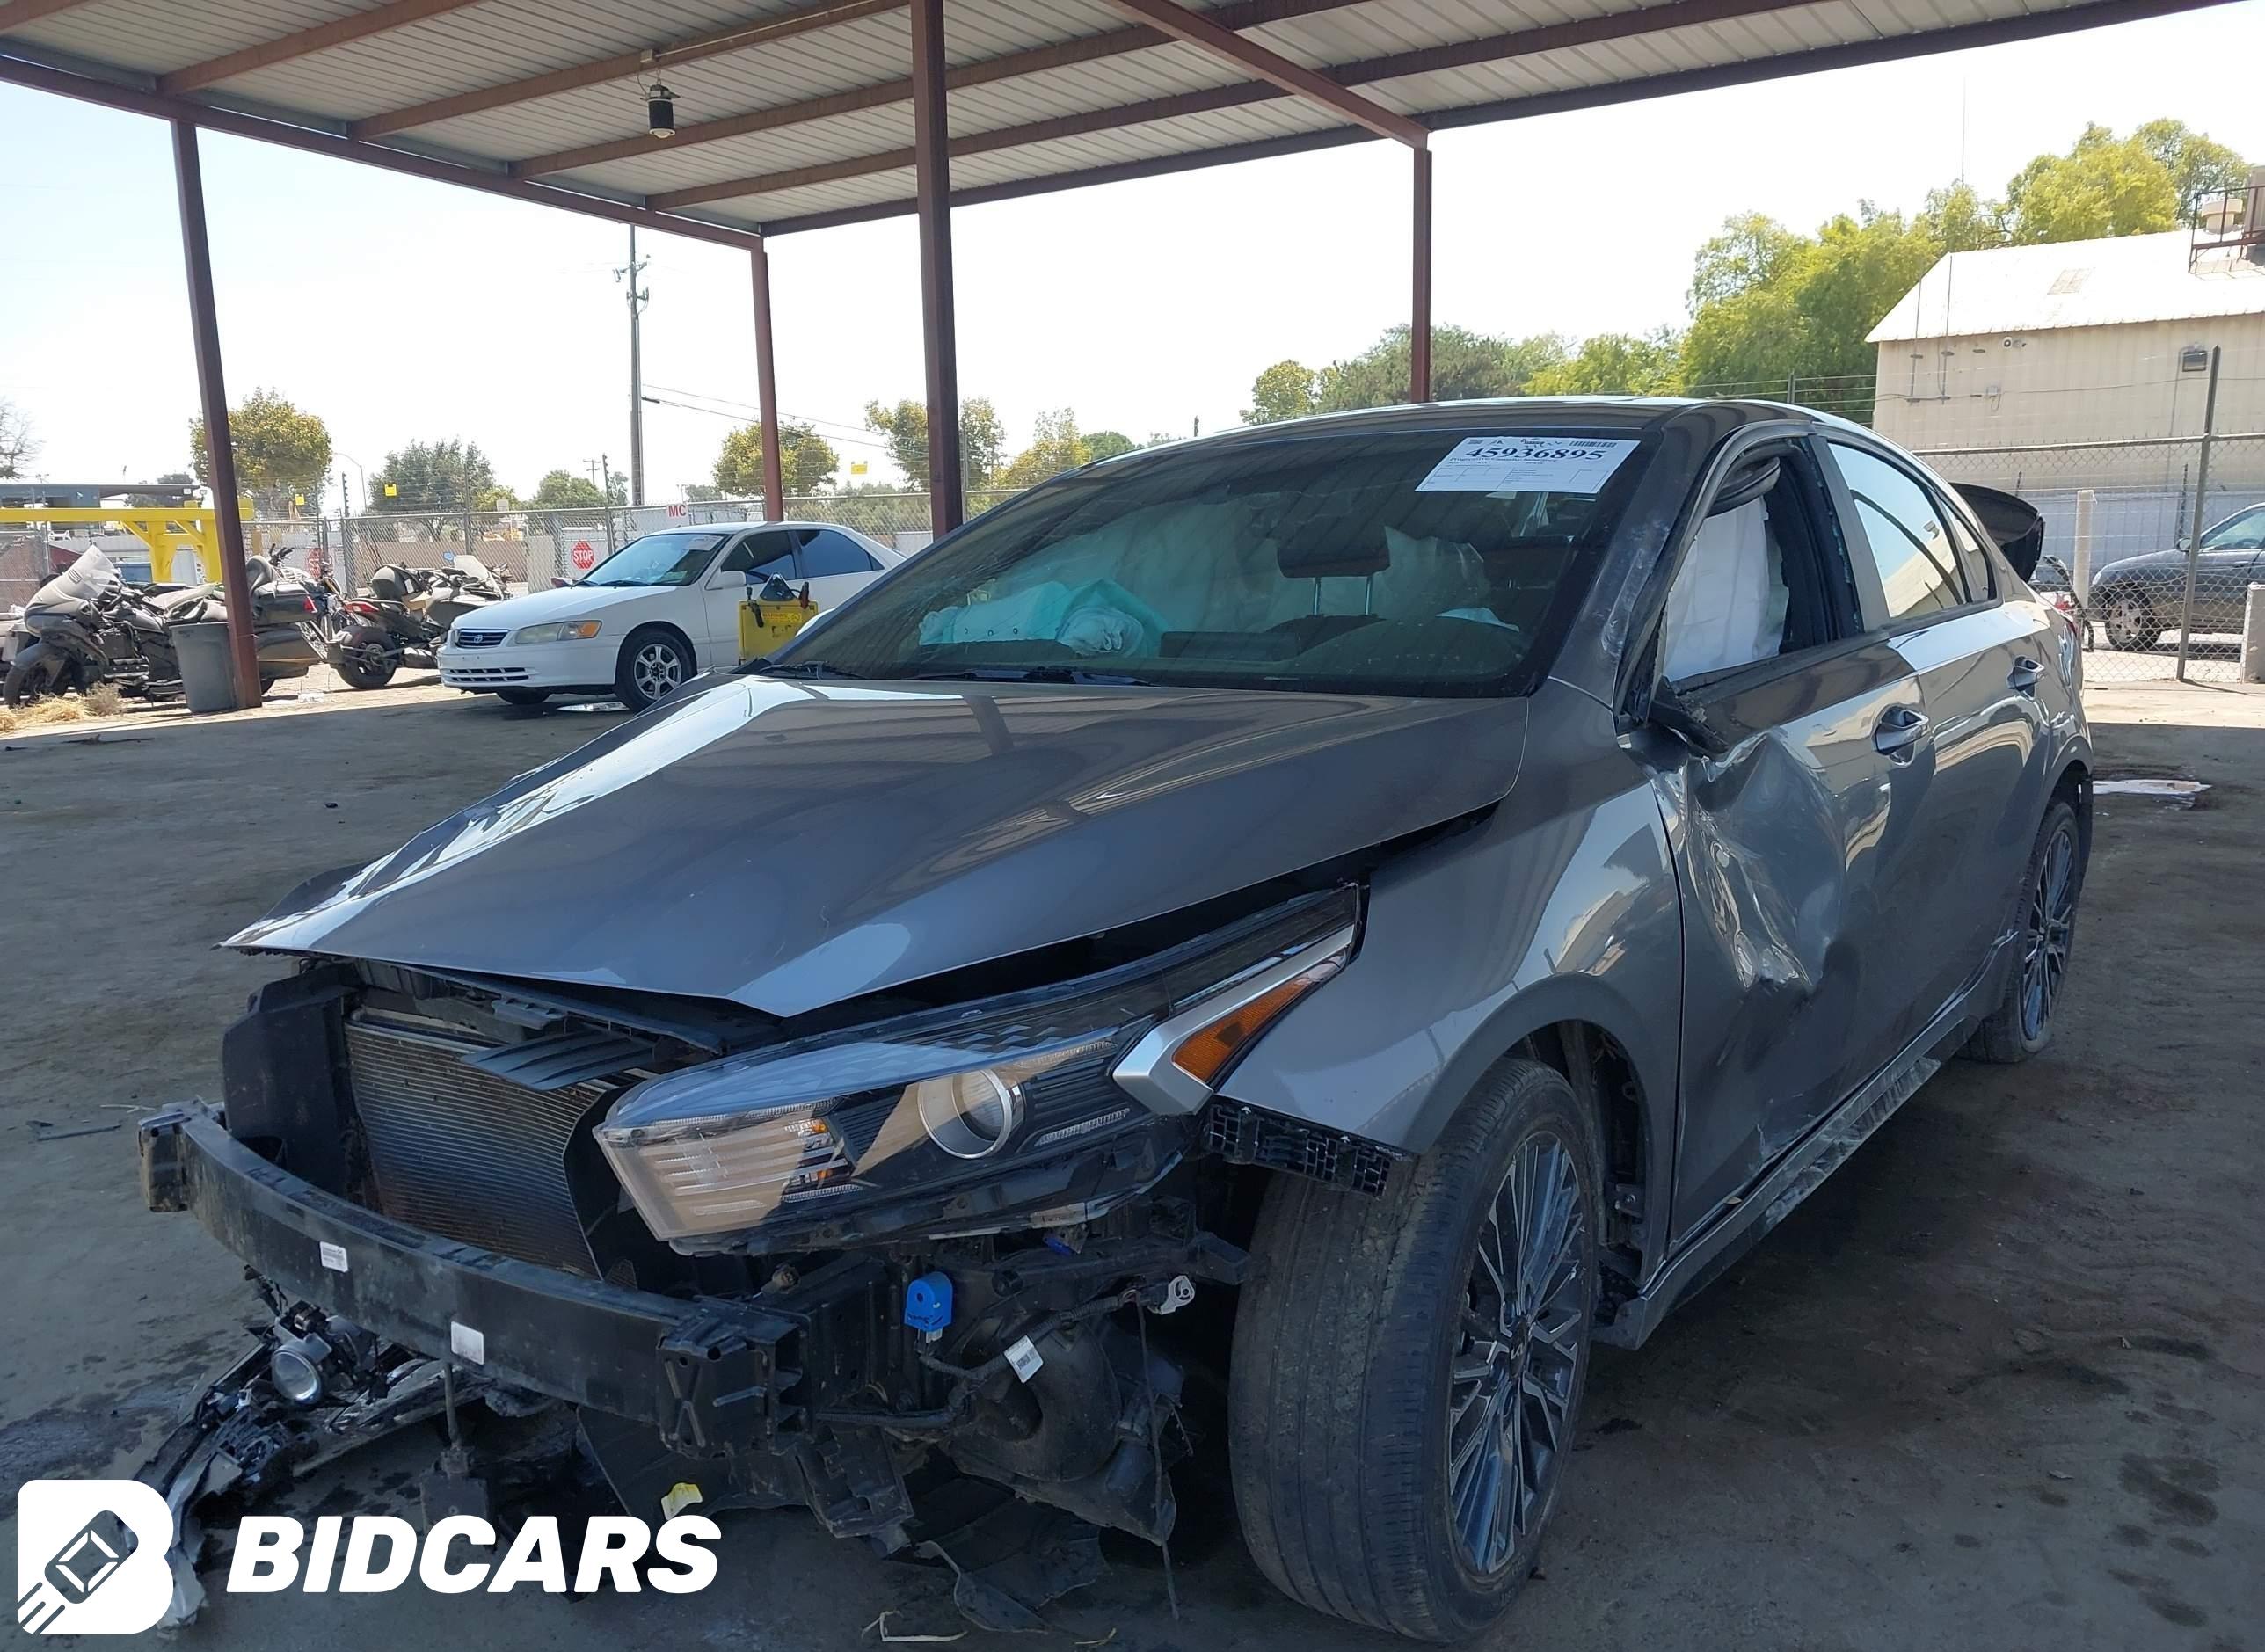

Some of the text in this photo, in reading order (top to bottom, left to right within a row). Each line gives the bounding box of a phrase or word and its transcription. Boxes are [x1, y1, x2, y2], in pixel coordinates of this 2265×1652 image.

[1465, 447, 1607, 461] 45936895
[668, 504, 687, 517] MC
[572, 549, 594, 562] STOP
